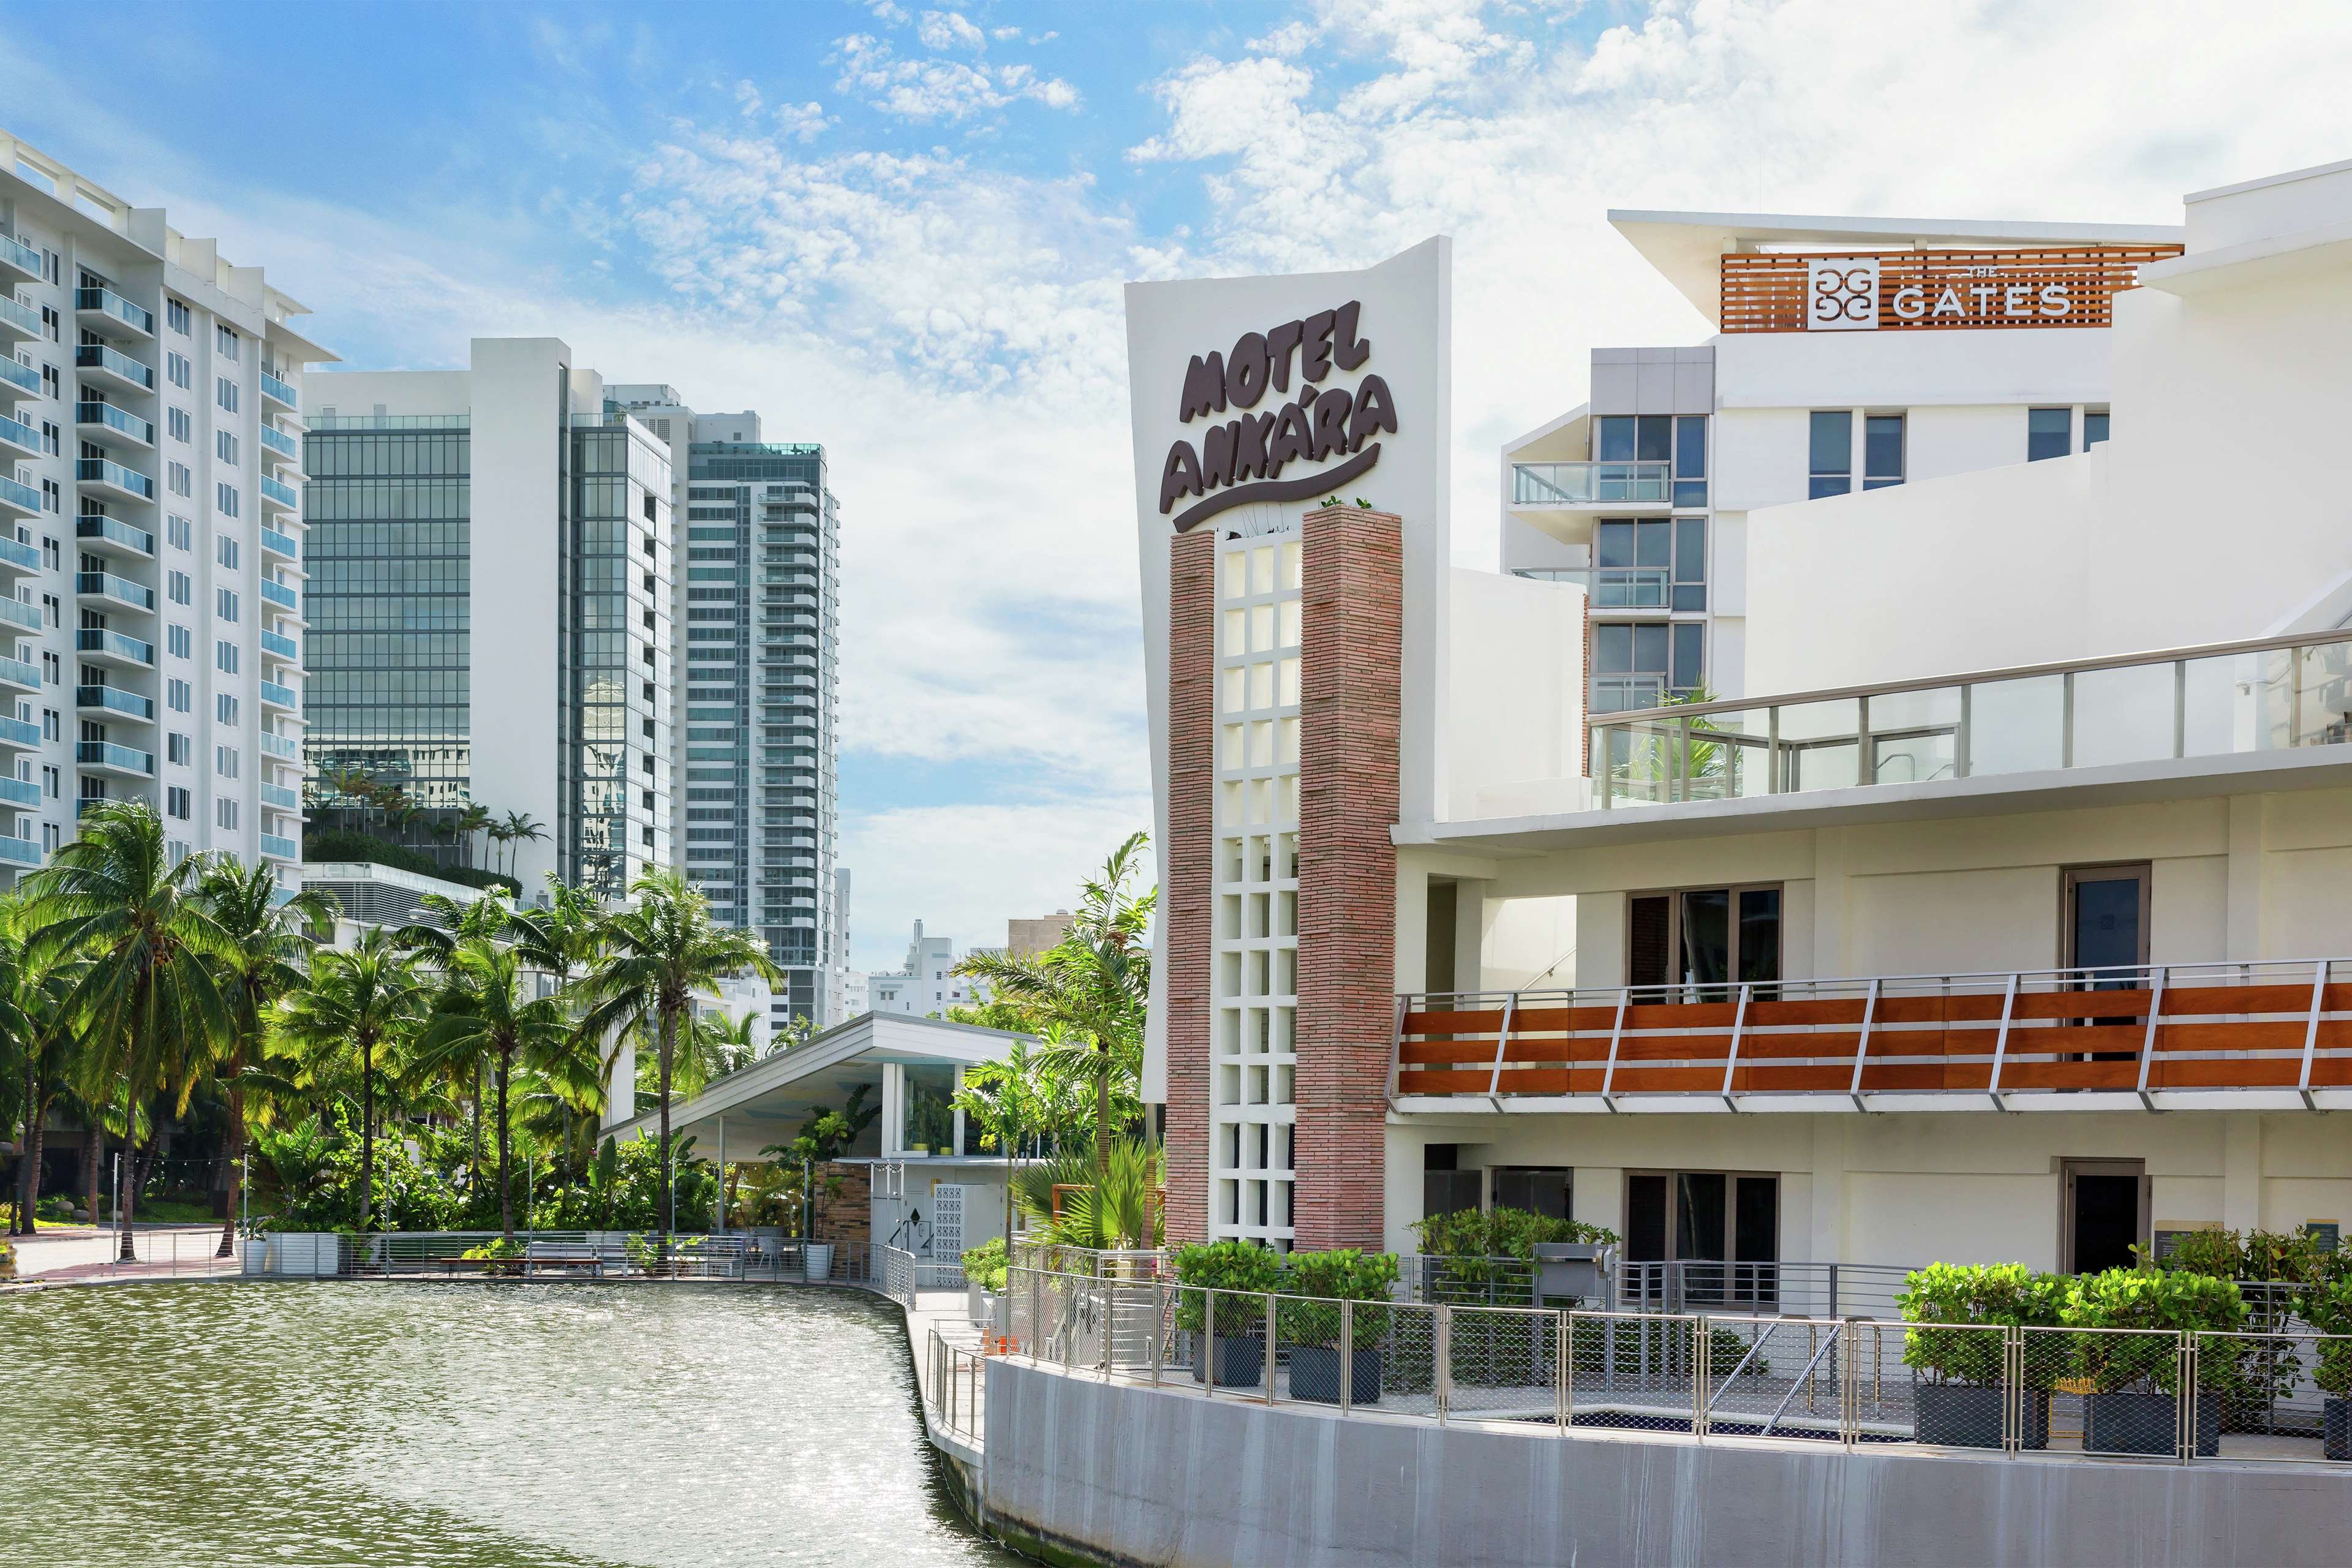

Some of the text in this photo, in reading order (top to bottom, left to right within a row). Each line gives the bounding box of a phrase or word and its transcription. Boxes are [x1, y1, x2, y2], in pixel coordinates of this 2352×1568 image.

[1967, 266, 1997, 278] THE
[1893, 285, 2071, 318] GATES
[1179, 299, 1370, 424] MOTEL
